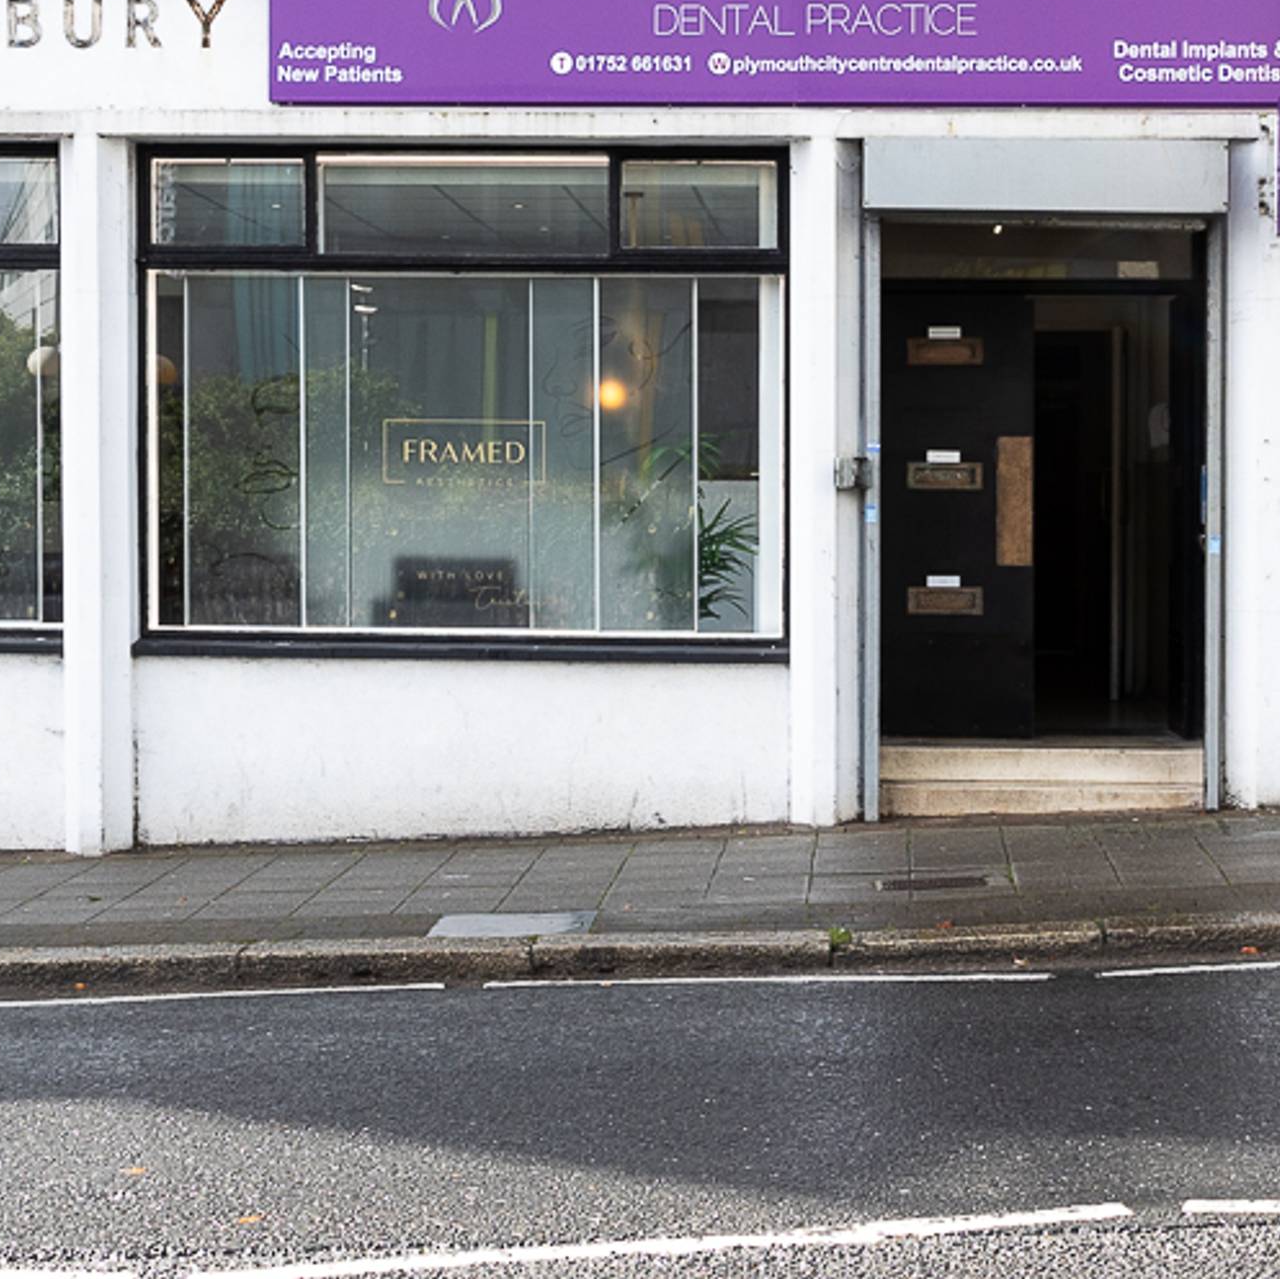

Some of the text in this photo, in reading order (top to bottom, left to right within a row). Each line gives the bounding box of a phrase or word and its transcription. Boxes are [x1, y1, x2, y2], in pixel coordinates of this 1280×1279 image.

[653, 3, 979, 36] DENTAL PRACTICE
[278, 41, 377, 64] Accepting
[1113, 40, 1178, 59] Dental
[1182, 40, 1269, 62] Implants
[277, 65, 404, 82] New Patients
[575, 54, 628, 72] 01752
[631, 54, 692, 72] 661631
[732, 54, 1083, 75] plymouthcitycentredentalpractice.co.uk
[1119, 63, 1214, 83] Cosmetic
[402, 438, 526, 464] FRAMED
[417, 570, 504, 581] WITH LOVE
